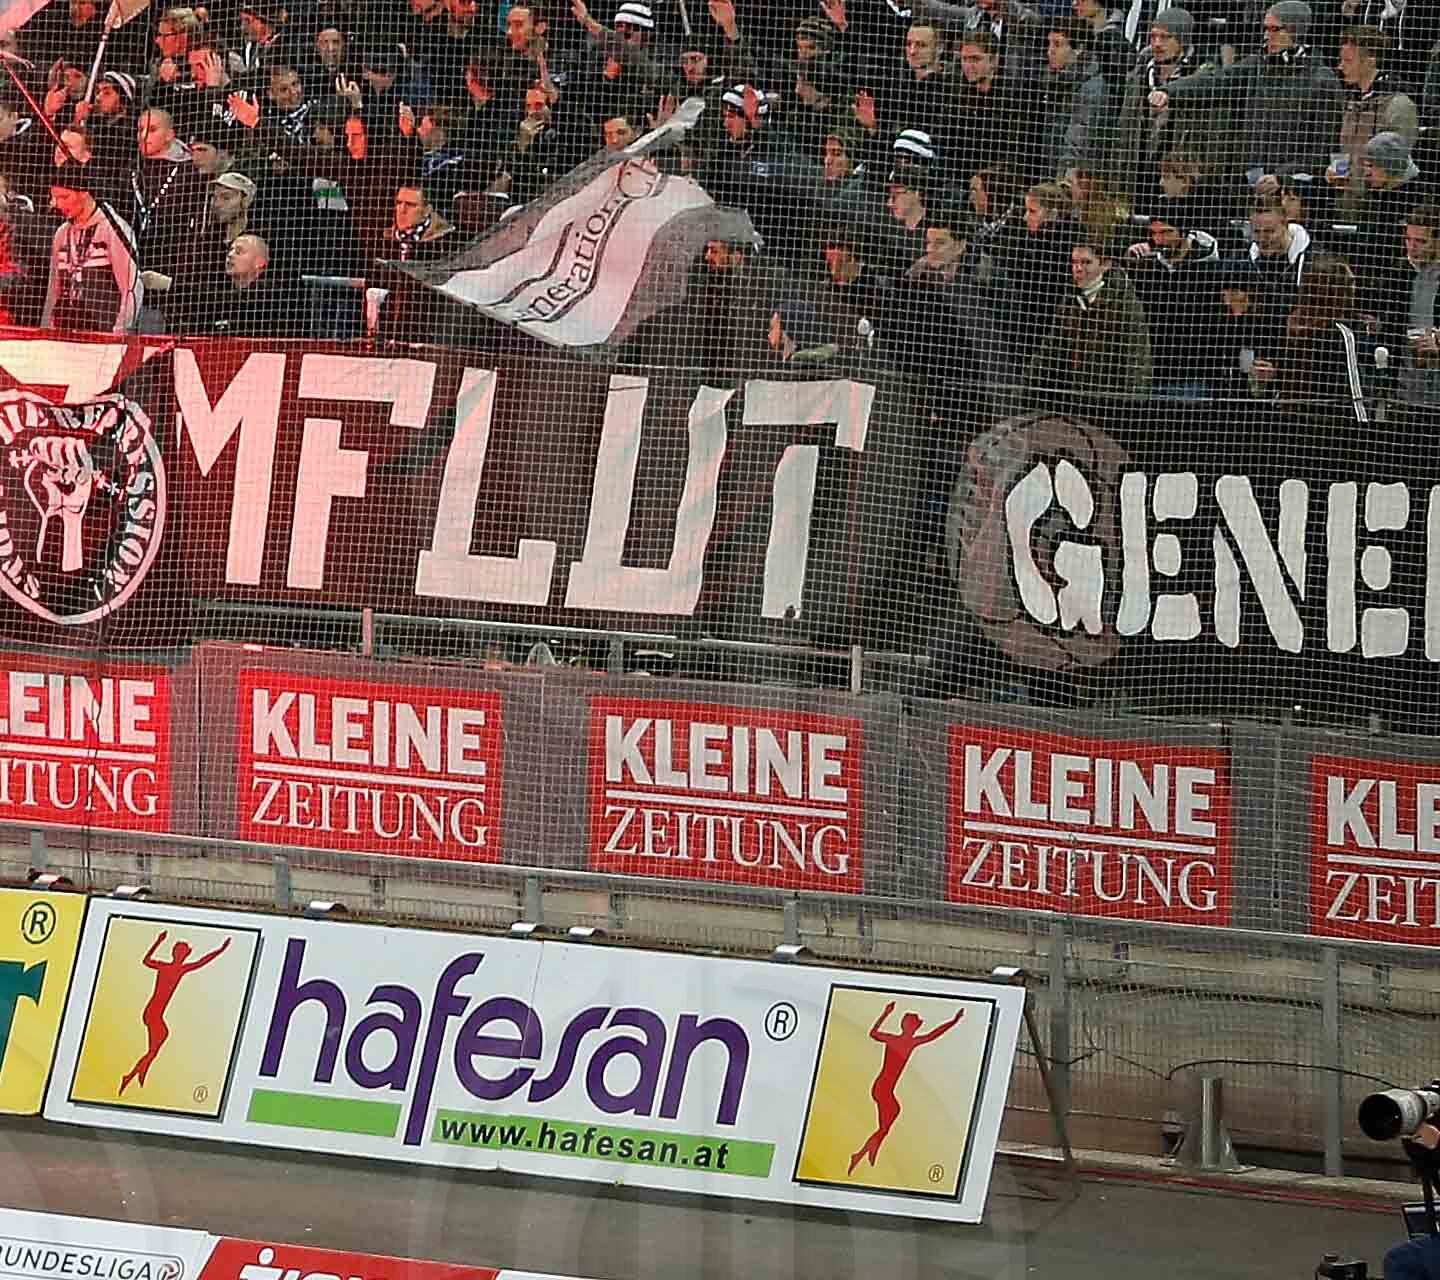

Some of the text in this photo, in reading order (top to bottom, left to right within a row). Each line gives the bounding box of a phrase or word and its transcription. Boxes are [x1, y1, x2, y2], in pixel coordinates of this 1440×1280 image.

[1007, 458, 1440, 664] GENE
[252, 689, 488, 776] KLEINE
[603, 715, 849, 803] KLEINE
[251, 775, 489, 848] ZEITUNG
[961, 743, 1217, 838] KLEINE
[602, 803, 852, 876] ZEITUNG
[960, 836, 1220, 912] ZEITUNG
[258, 937, 753, 1147] hafesan
[437, 1111, 733, 1173] www.hafesan.at
